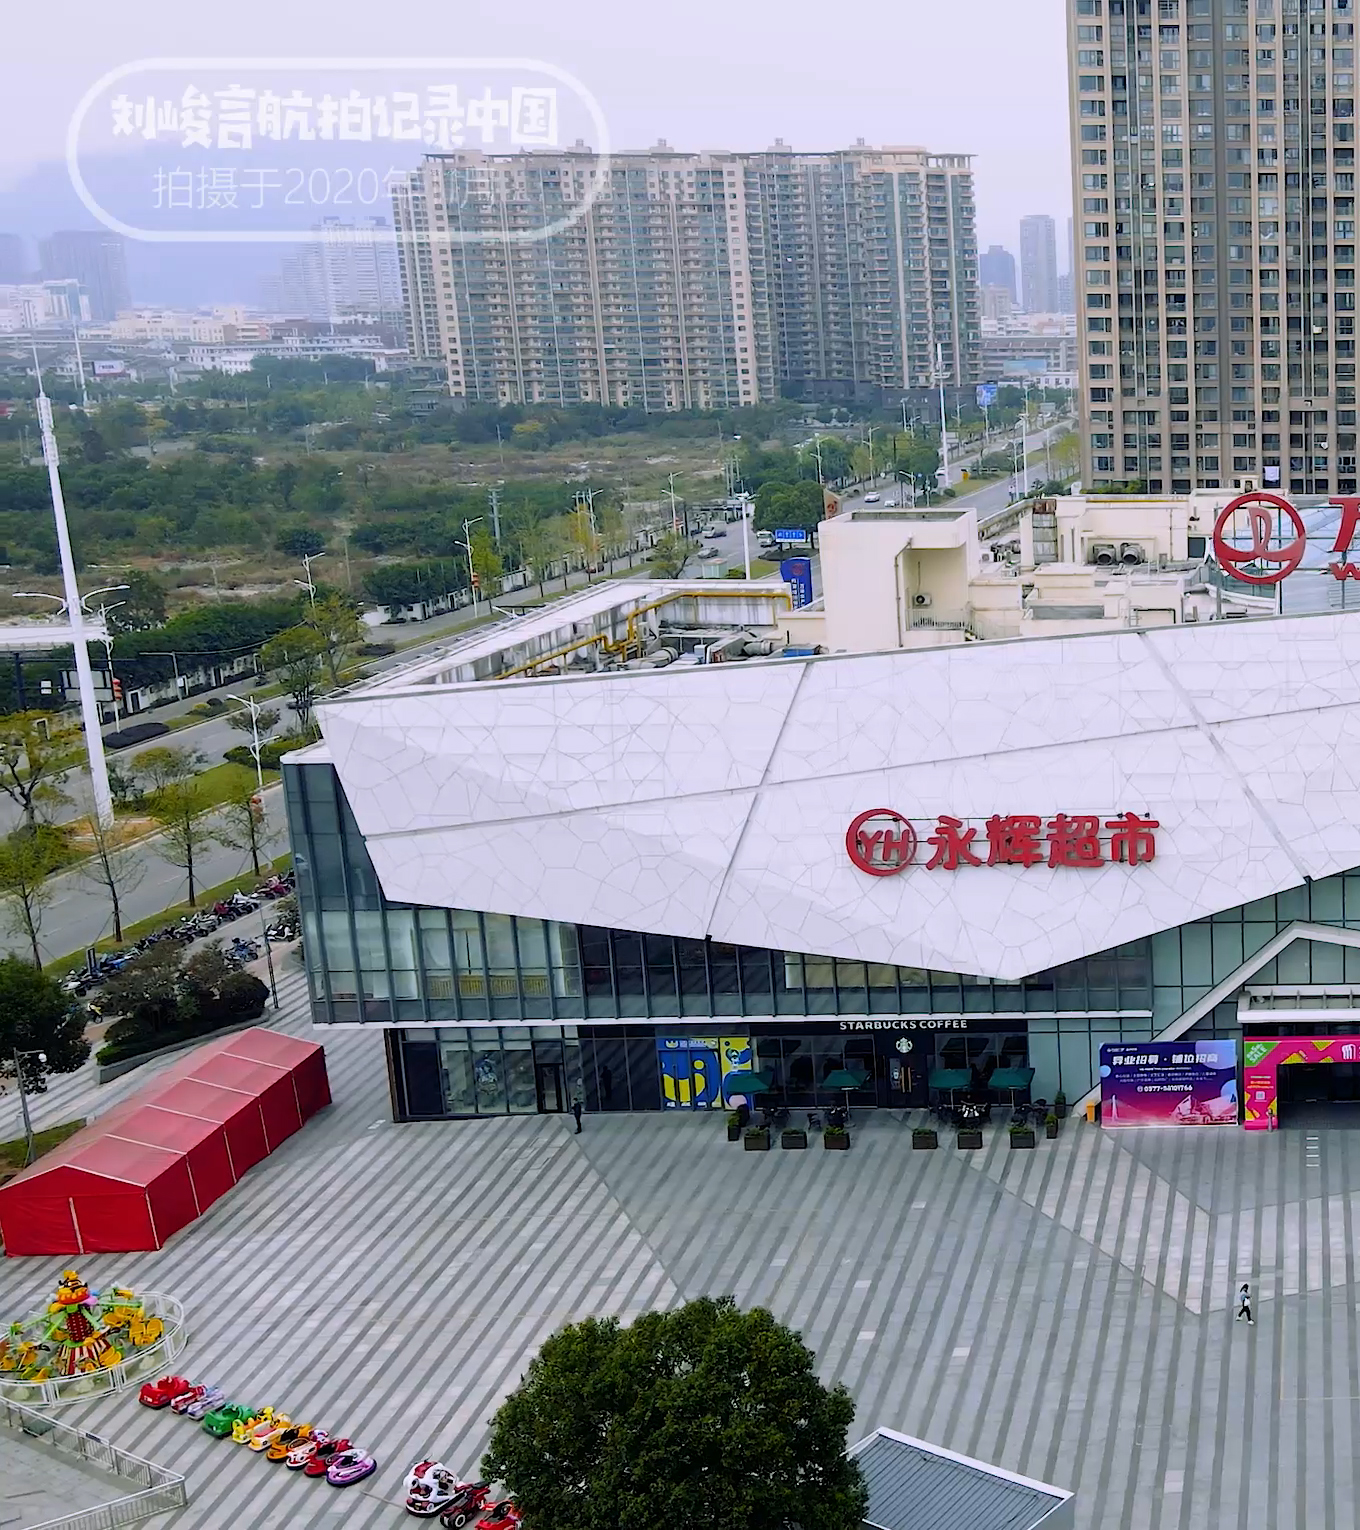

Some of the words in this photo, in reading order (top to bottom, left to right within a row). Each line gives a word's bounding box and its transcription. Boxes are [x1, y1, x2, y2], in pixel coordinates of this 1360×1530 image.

[926, 811, 1160, 871] 永辉超市
[840, 1021, 917, 1031] STARBUCKS
[919, 1020, 968, 1029] COFFEE
